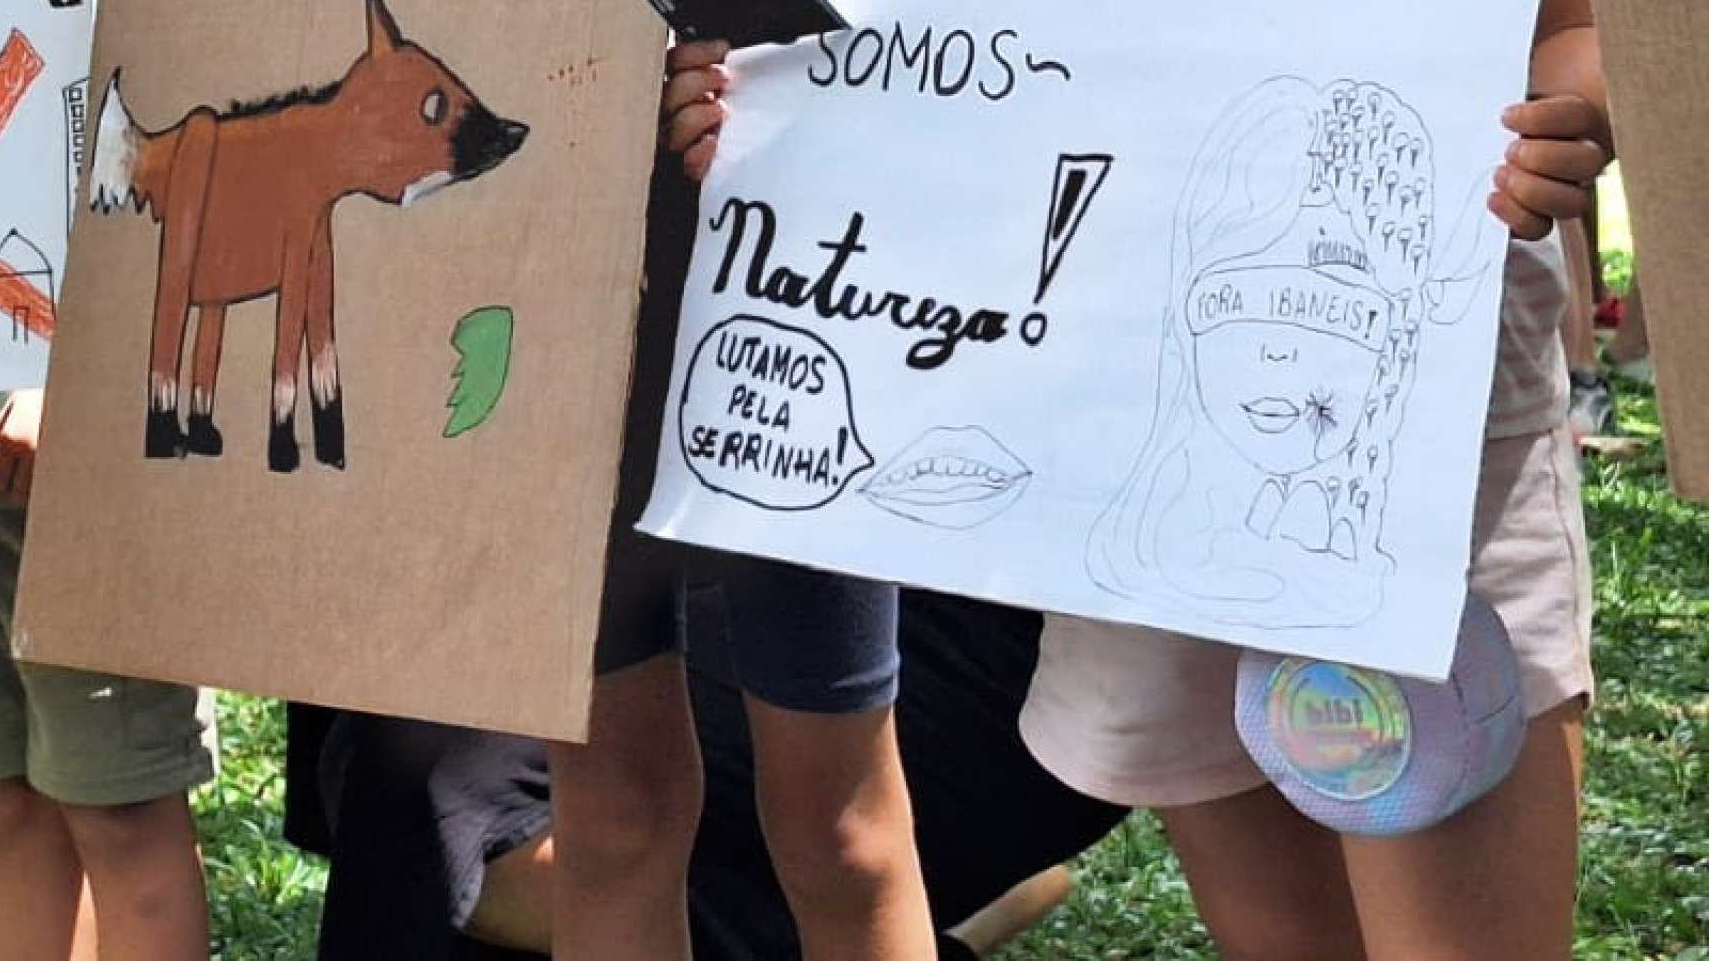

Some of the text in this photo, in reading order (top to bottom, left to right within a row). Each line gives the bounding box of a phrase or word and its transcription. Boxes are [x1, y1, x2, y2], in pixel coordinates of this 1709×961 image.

[717, 332, 826, 394] LUTAMOS
[729, 385, 790, 428] PELA
[692, 426, 848, 486] SERRINHA!
